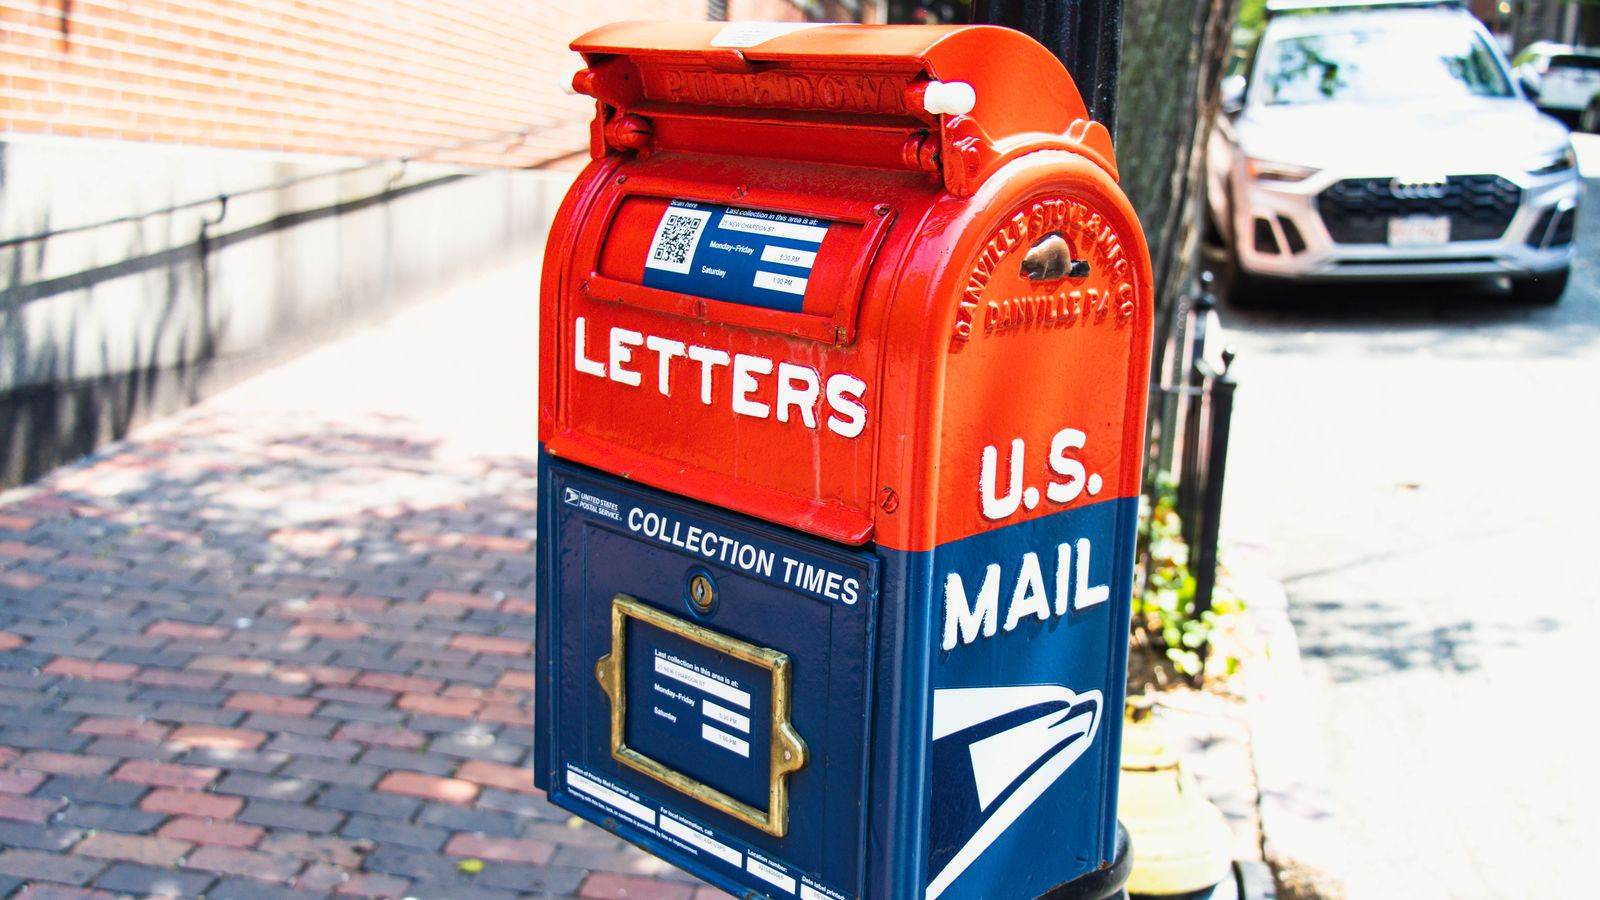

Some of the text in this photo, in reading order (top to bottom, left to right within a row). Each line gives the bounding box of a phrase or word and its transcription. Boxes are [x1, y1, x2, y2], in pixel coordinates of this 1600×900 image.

[725, 207, 740, 215] Last
[739, 210, 768, 219] collection
[775, 214, 787, 222] this
[788, 216, 802, 224] area
[701, 265, 727, 279] Saturday
[986, 291, 1081, 325] DANVILLE
[574, 316, 868, 438] LETTERS
[979, 428, 1103, 519] U.S.
[580, 492, 618, 511] UNITED STATES
[580, 501, 599, 513] POSTAL
[628, 507, 860, 605] COLLECTION TIMES
[942, 538, 1110, 650] MAIL
[655, 648, 667, 658] Last
[667, 654, 694, 669] collection
[694, 664, 700, 672] in
[700, 667, 711, 677] this
[711, 672, 724, 682] area
[724, 676, 731, 685] is
[654, 706, 677, 724] Saturday
[747, 848, 768, 863] Location
[801, 875, 814, 886] Date
[813, 881, 827, 892] label
